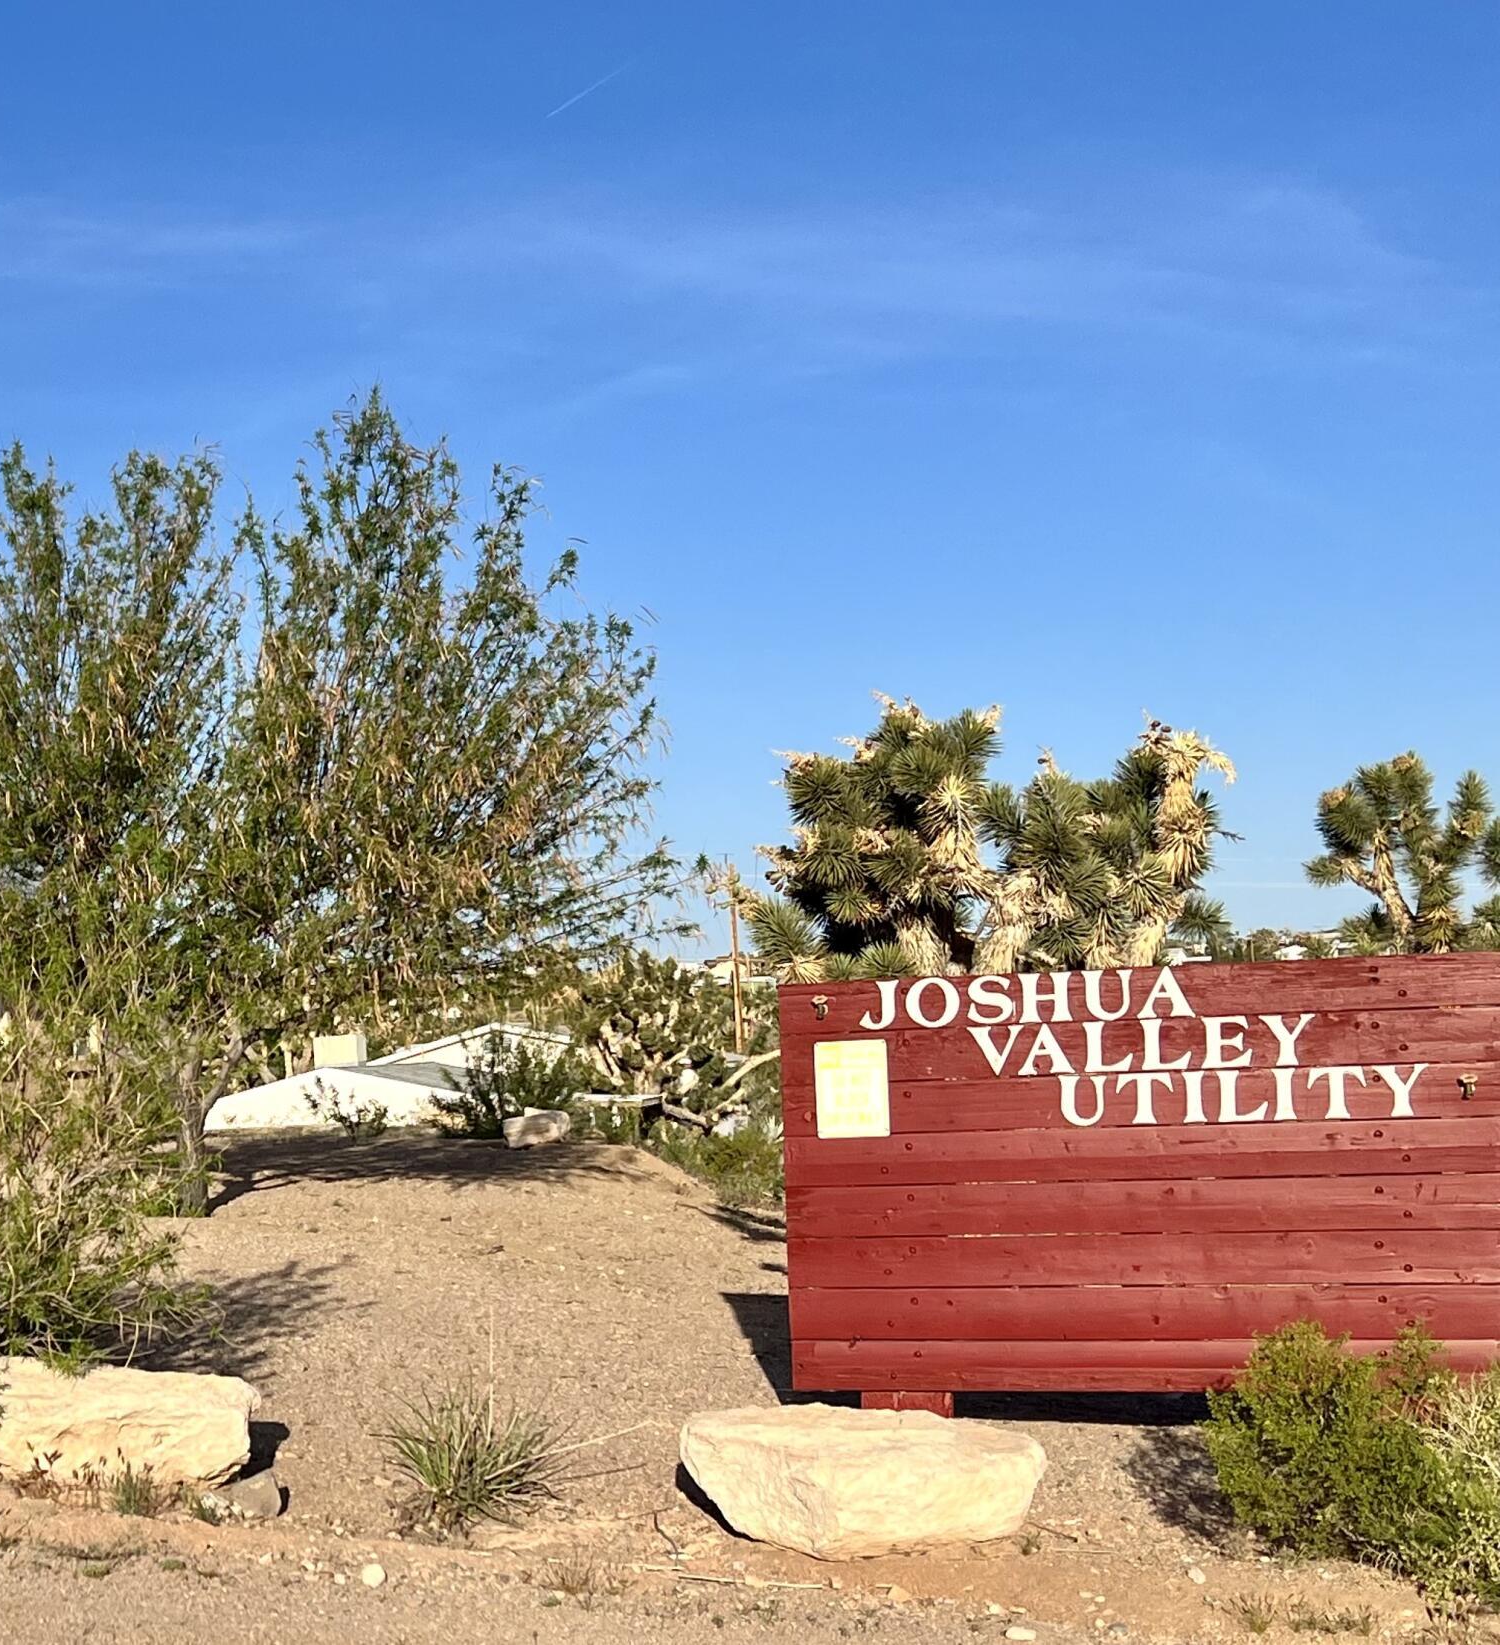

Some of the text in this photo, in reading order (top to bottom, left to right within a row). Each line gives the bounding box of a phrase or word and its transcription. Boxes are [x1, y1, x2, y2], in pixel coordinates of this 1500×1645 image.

[859, 965, 1196, 1031] JOSHUA
[966, 1013, 1316, 1076] VALLEY
[1058, 1062, 1430, 1127] UTILITY
